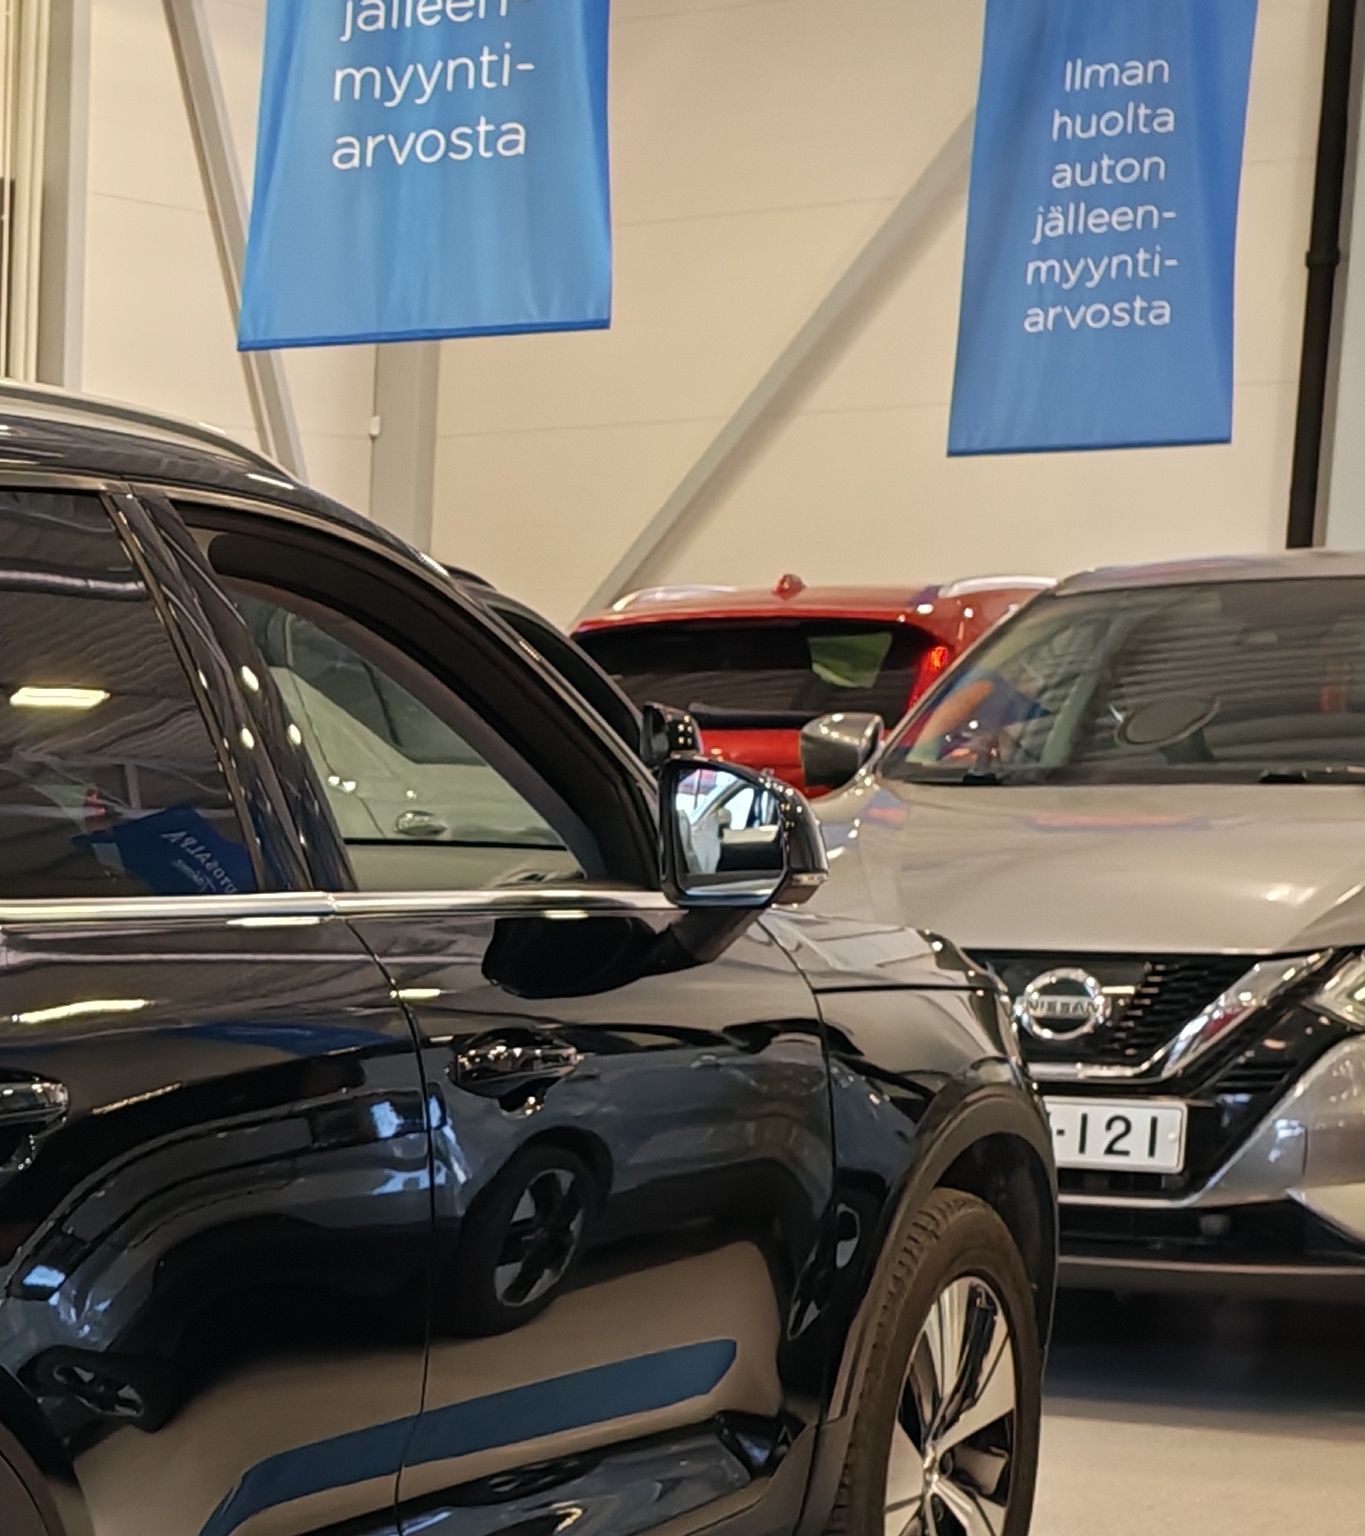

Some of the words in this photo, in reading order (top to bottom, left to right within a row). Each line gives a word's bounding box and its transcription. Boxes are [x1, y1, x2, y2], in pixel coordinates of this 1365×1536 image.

[333, 42, 536, 108] myynti-
[1064, 57, 1170, 92] Ilman
[1051, 101, 1176, 141] huolta
[331, 115, 527, 170] arvosta
[1051, 154, 1166, 189] auton
[1032, 202, 1177, 245] jälleen-
[1026, 245, 1179, 289] myynti-
[1023, 295, 1172, 334] arvosta
[1028, 1001, 1100, 1015] NISSAN
